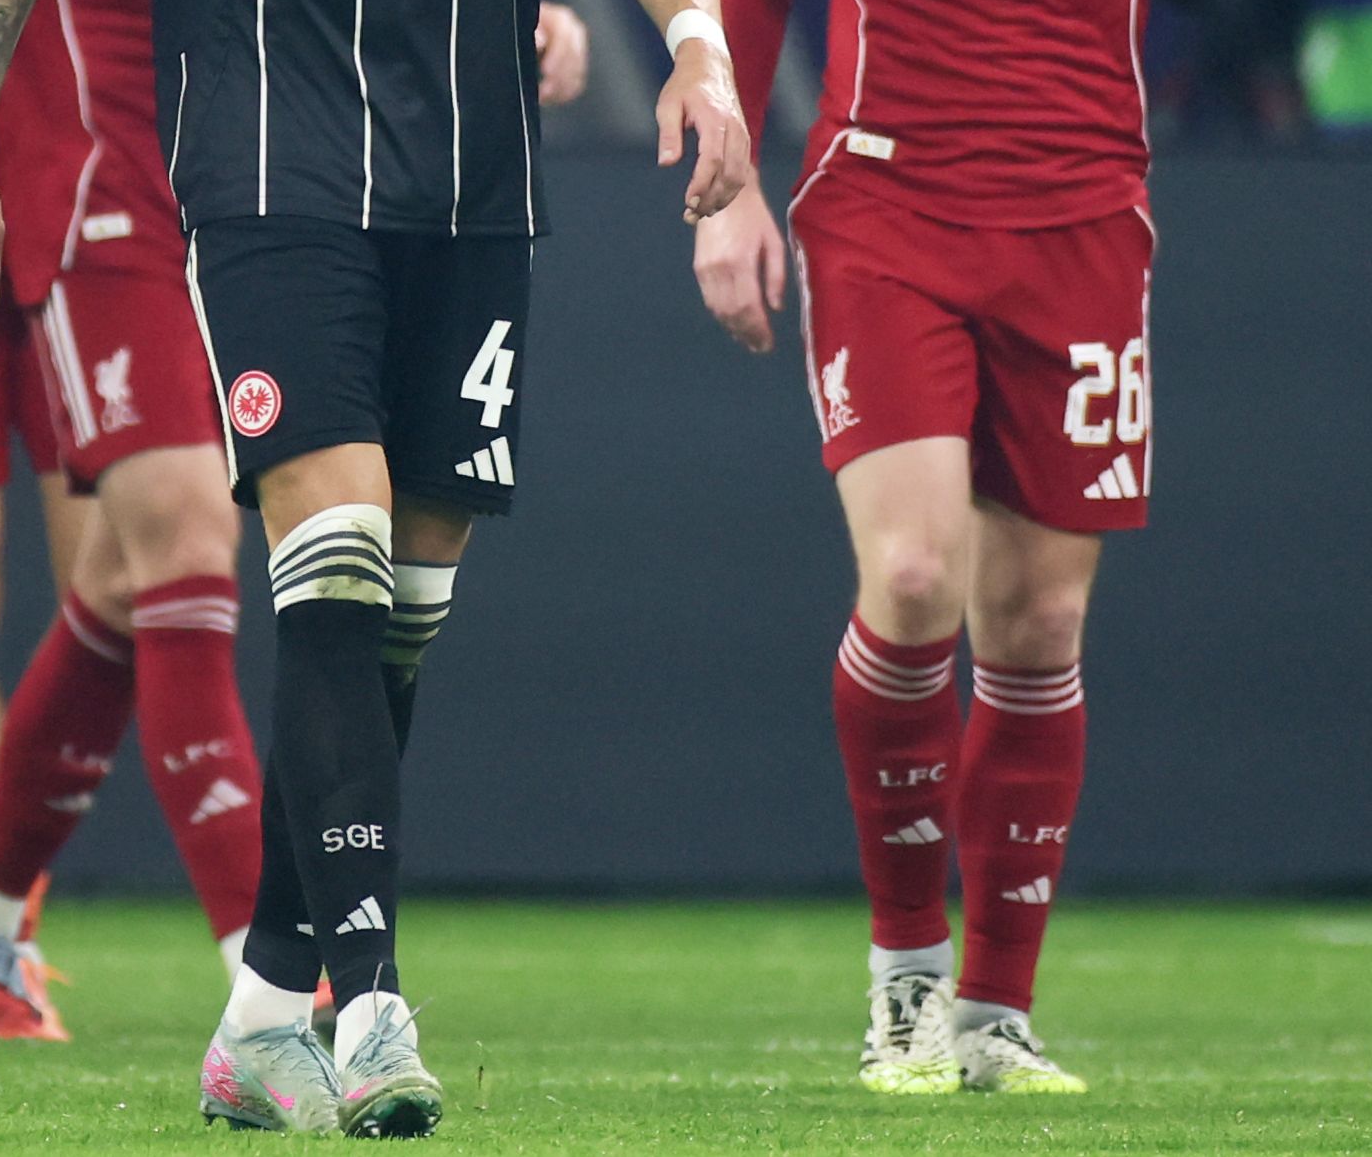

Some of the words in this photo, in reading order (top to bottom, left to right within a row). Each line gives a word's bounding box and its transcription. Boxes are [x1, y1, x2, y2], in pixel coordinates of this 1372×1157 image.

[461, 320, 515, 429] 4
[1063, 337, 1147, 447] 26
[322, 824, 385, 852] SGE
